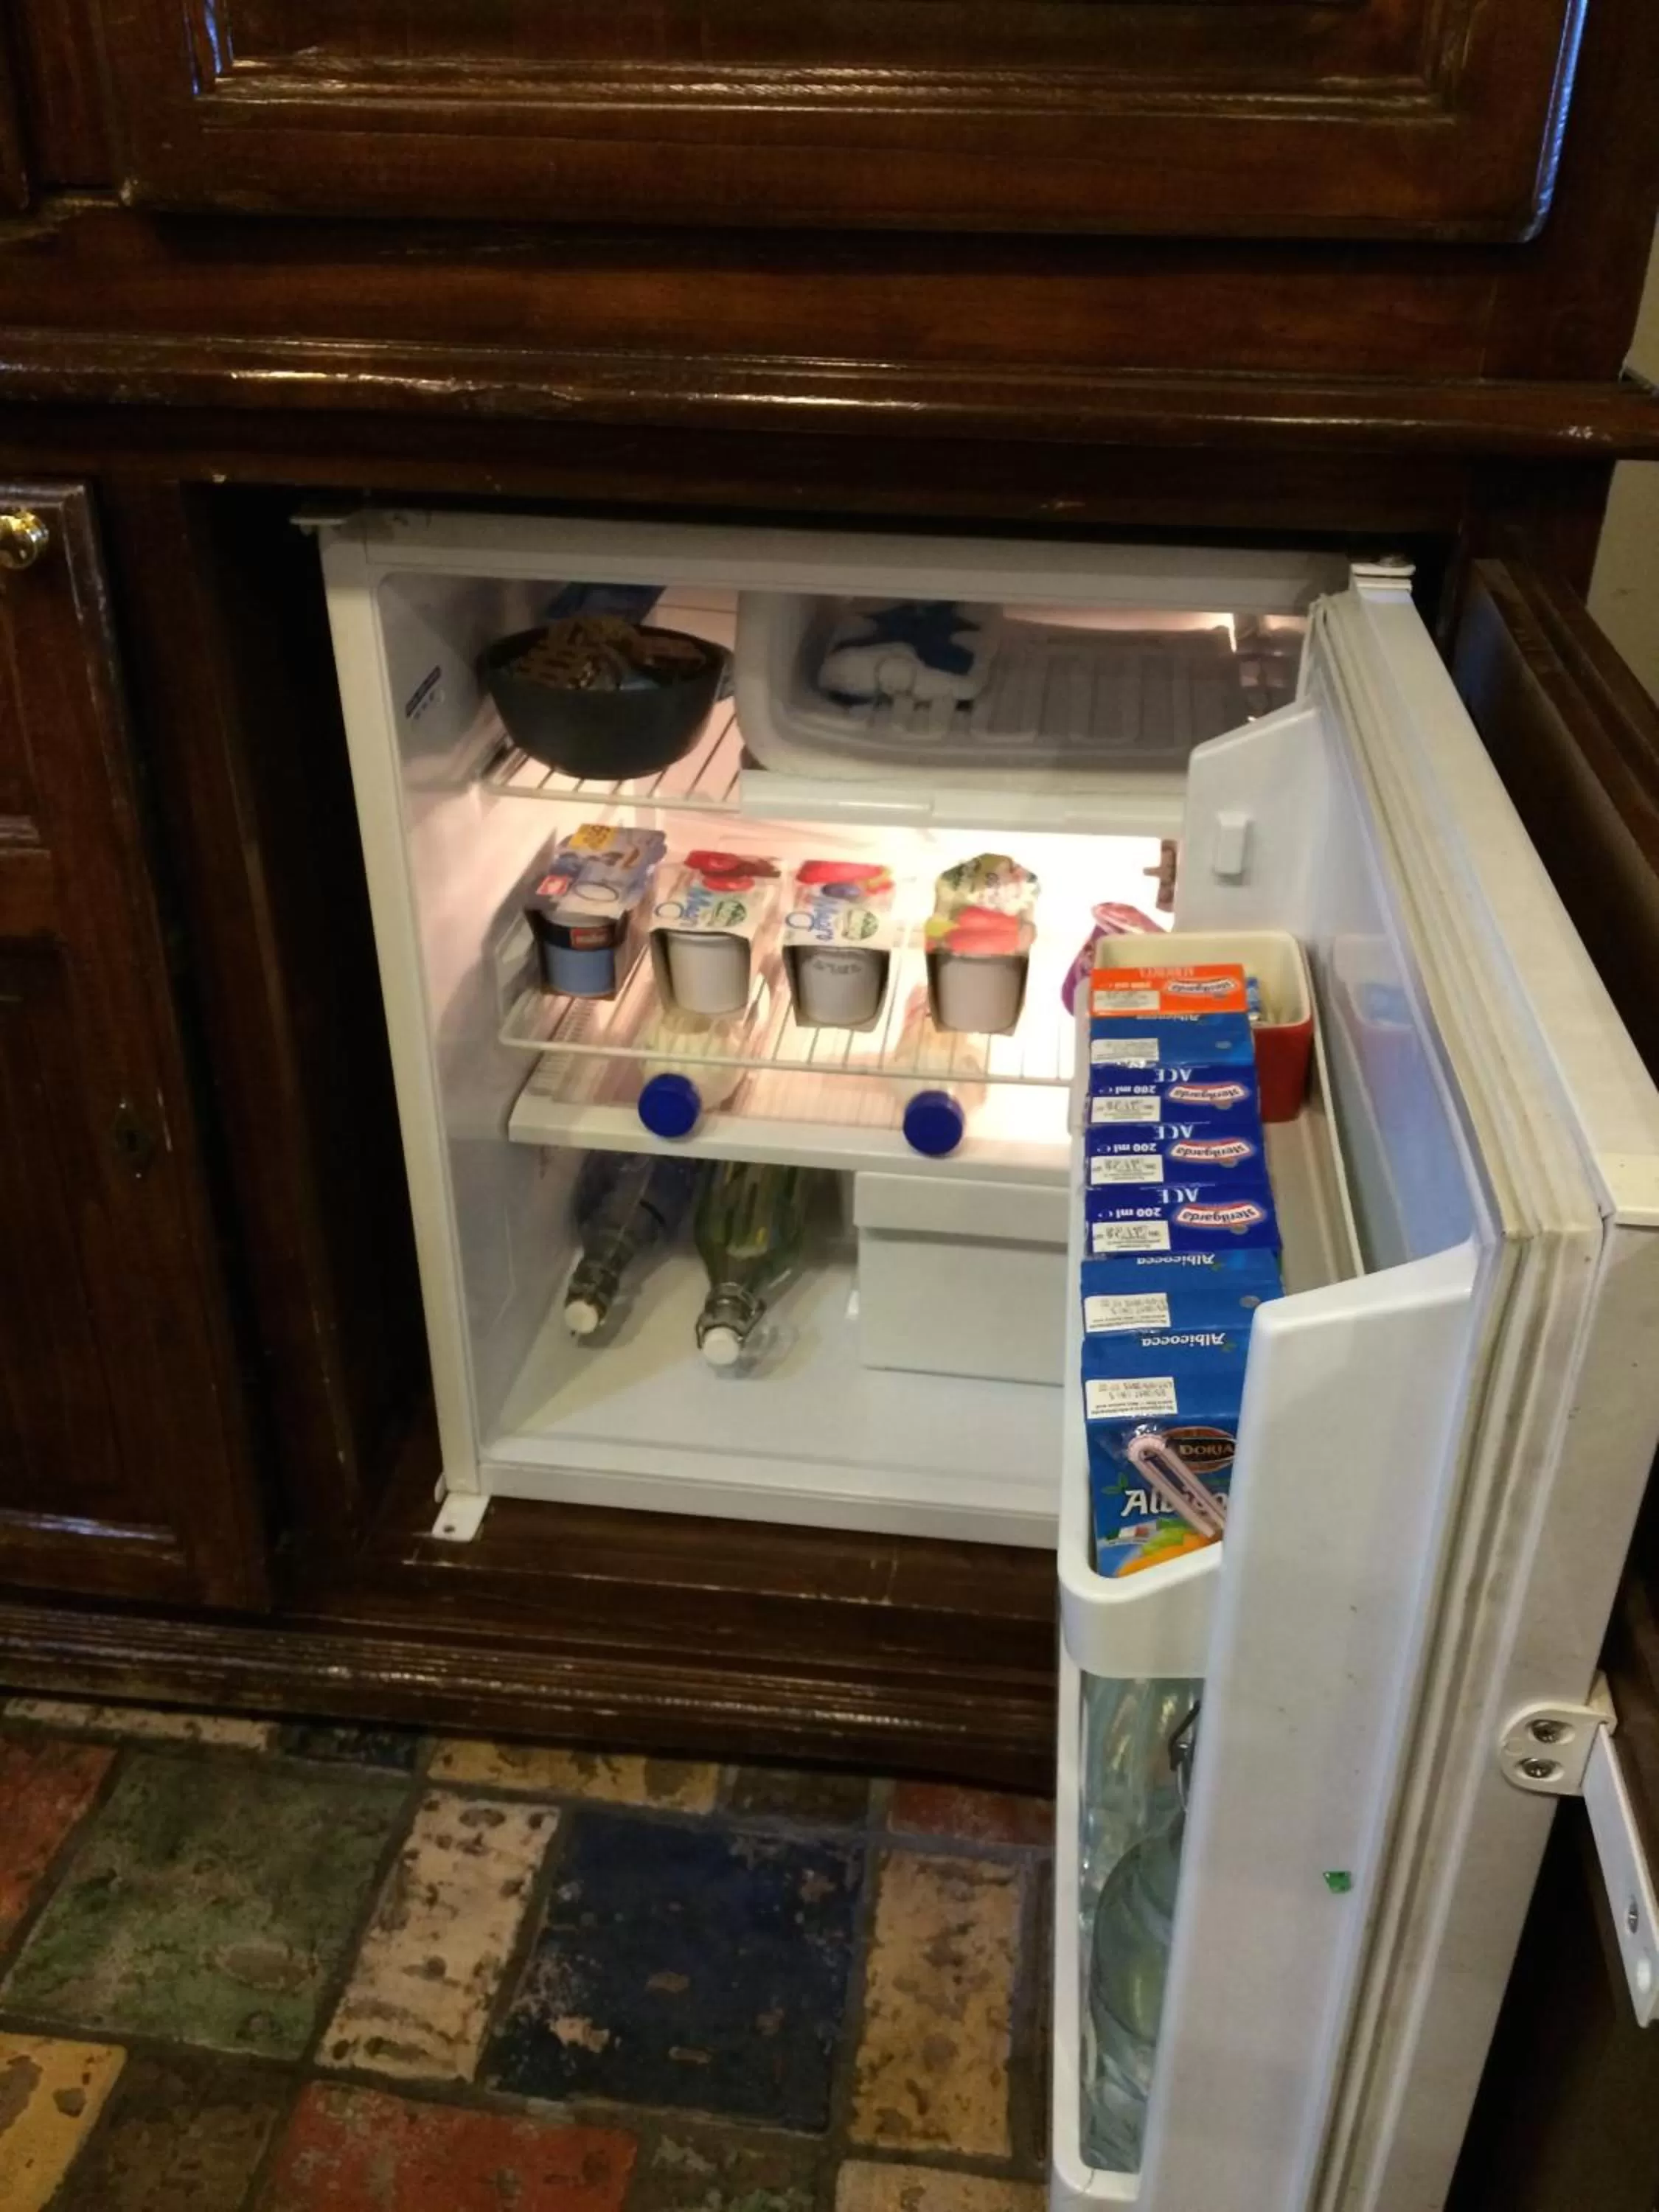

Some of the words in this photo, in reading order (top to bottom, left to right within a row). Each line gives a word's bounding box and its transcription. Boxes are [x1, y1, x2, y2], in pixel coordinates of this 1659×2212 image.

[1114, 1085, 1129, 1094] ml
[1134, 1085, 1157, 1094] 200
[1113, 1144, 1131, 1153] ml
[1133, 1143, 1158, 1152] 200
[1115, 1208, 1134, 1217] ml
[1136, 1207, 1162, 1217] 200
[1142, 1332, 1227, 1347] Albicocca
